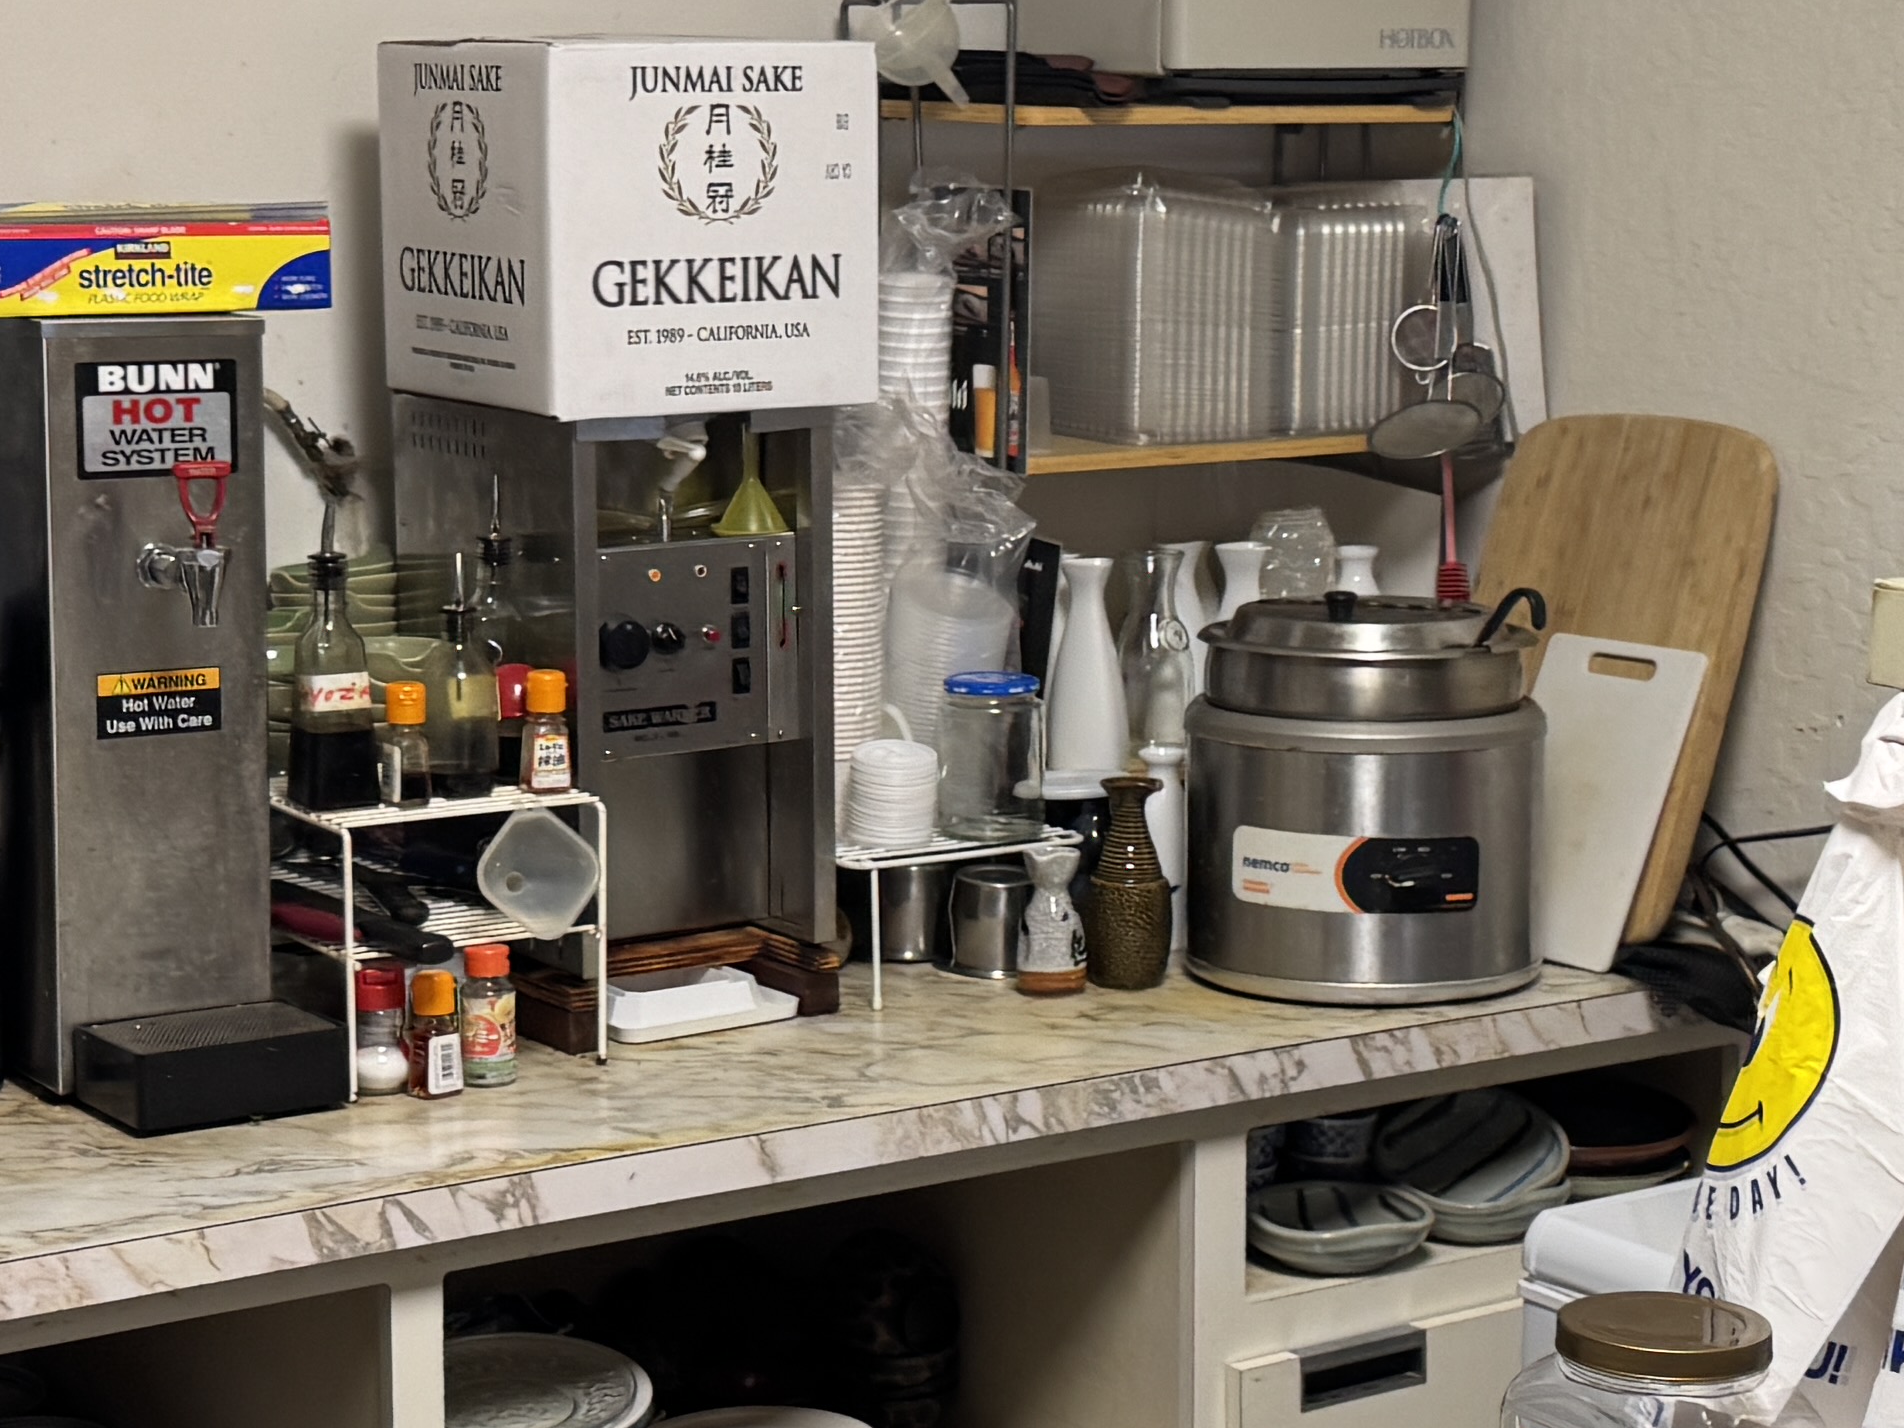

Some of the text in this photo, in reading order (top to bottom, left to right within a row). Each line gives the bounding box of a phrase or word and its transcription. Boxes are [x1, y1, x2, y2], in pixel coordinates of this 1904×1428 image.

[414, 63, 503, 95] JUNMAI SAKE
[629, 65, 803, 101] JUNMAI SAKE
[703, 103, 734, 214] 月桂冠
[79, 261, 213, 289] stretch-tite
[400, 246, 526, 308] GEKKEIKAN
[592, 253, 842, 308] GEKKEIKAN
[627, 329, 653, 345] EST.
[656, 328, 685, 344] 1989
[784, 322, 810, 338] USA
[96, 363, 215, 394] BUNN
[112, 397, 202, 425] HOT
[109, 426, 207, 446] WATER
[101, 446, 215, 467] SYSTEM
[131, 673, 207, 691] WARNING
[122, 695, 196, 713] Hot Water
[106, 714, 213, 734] Use With Care
[1242, 856, 1290, 873] nemco
